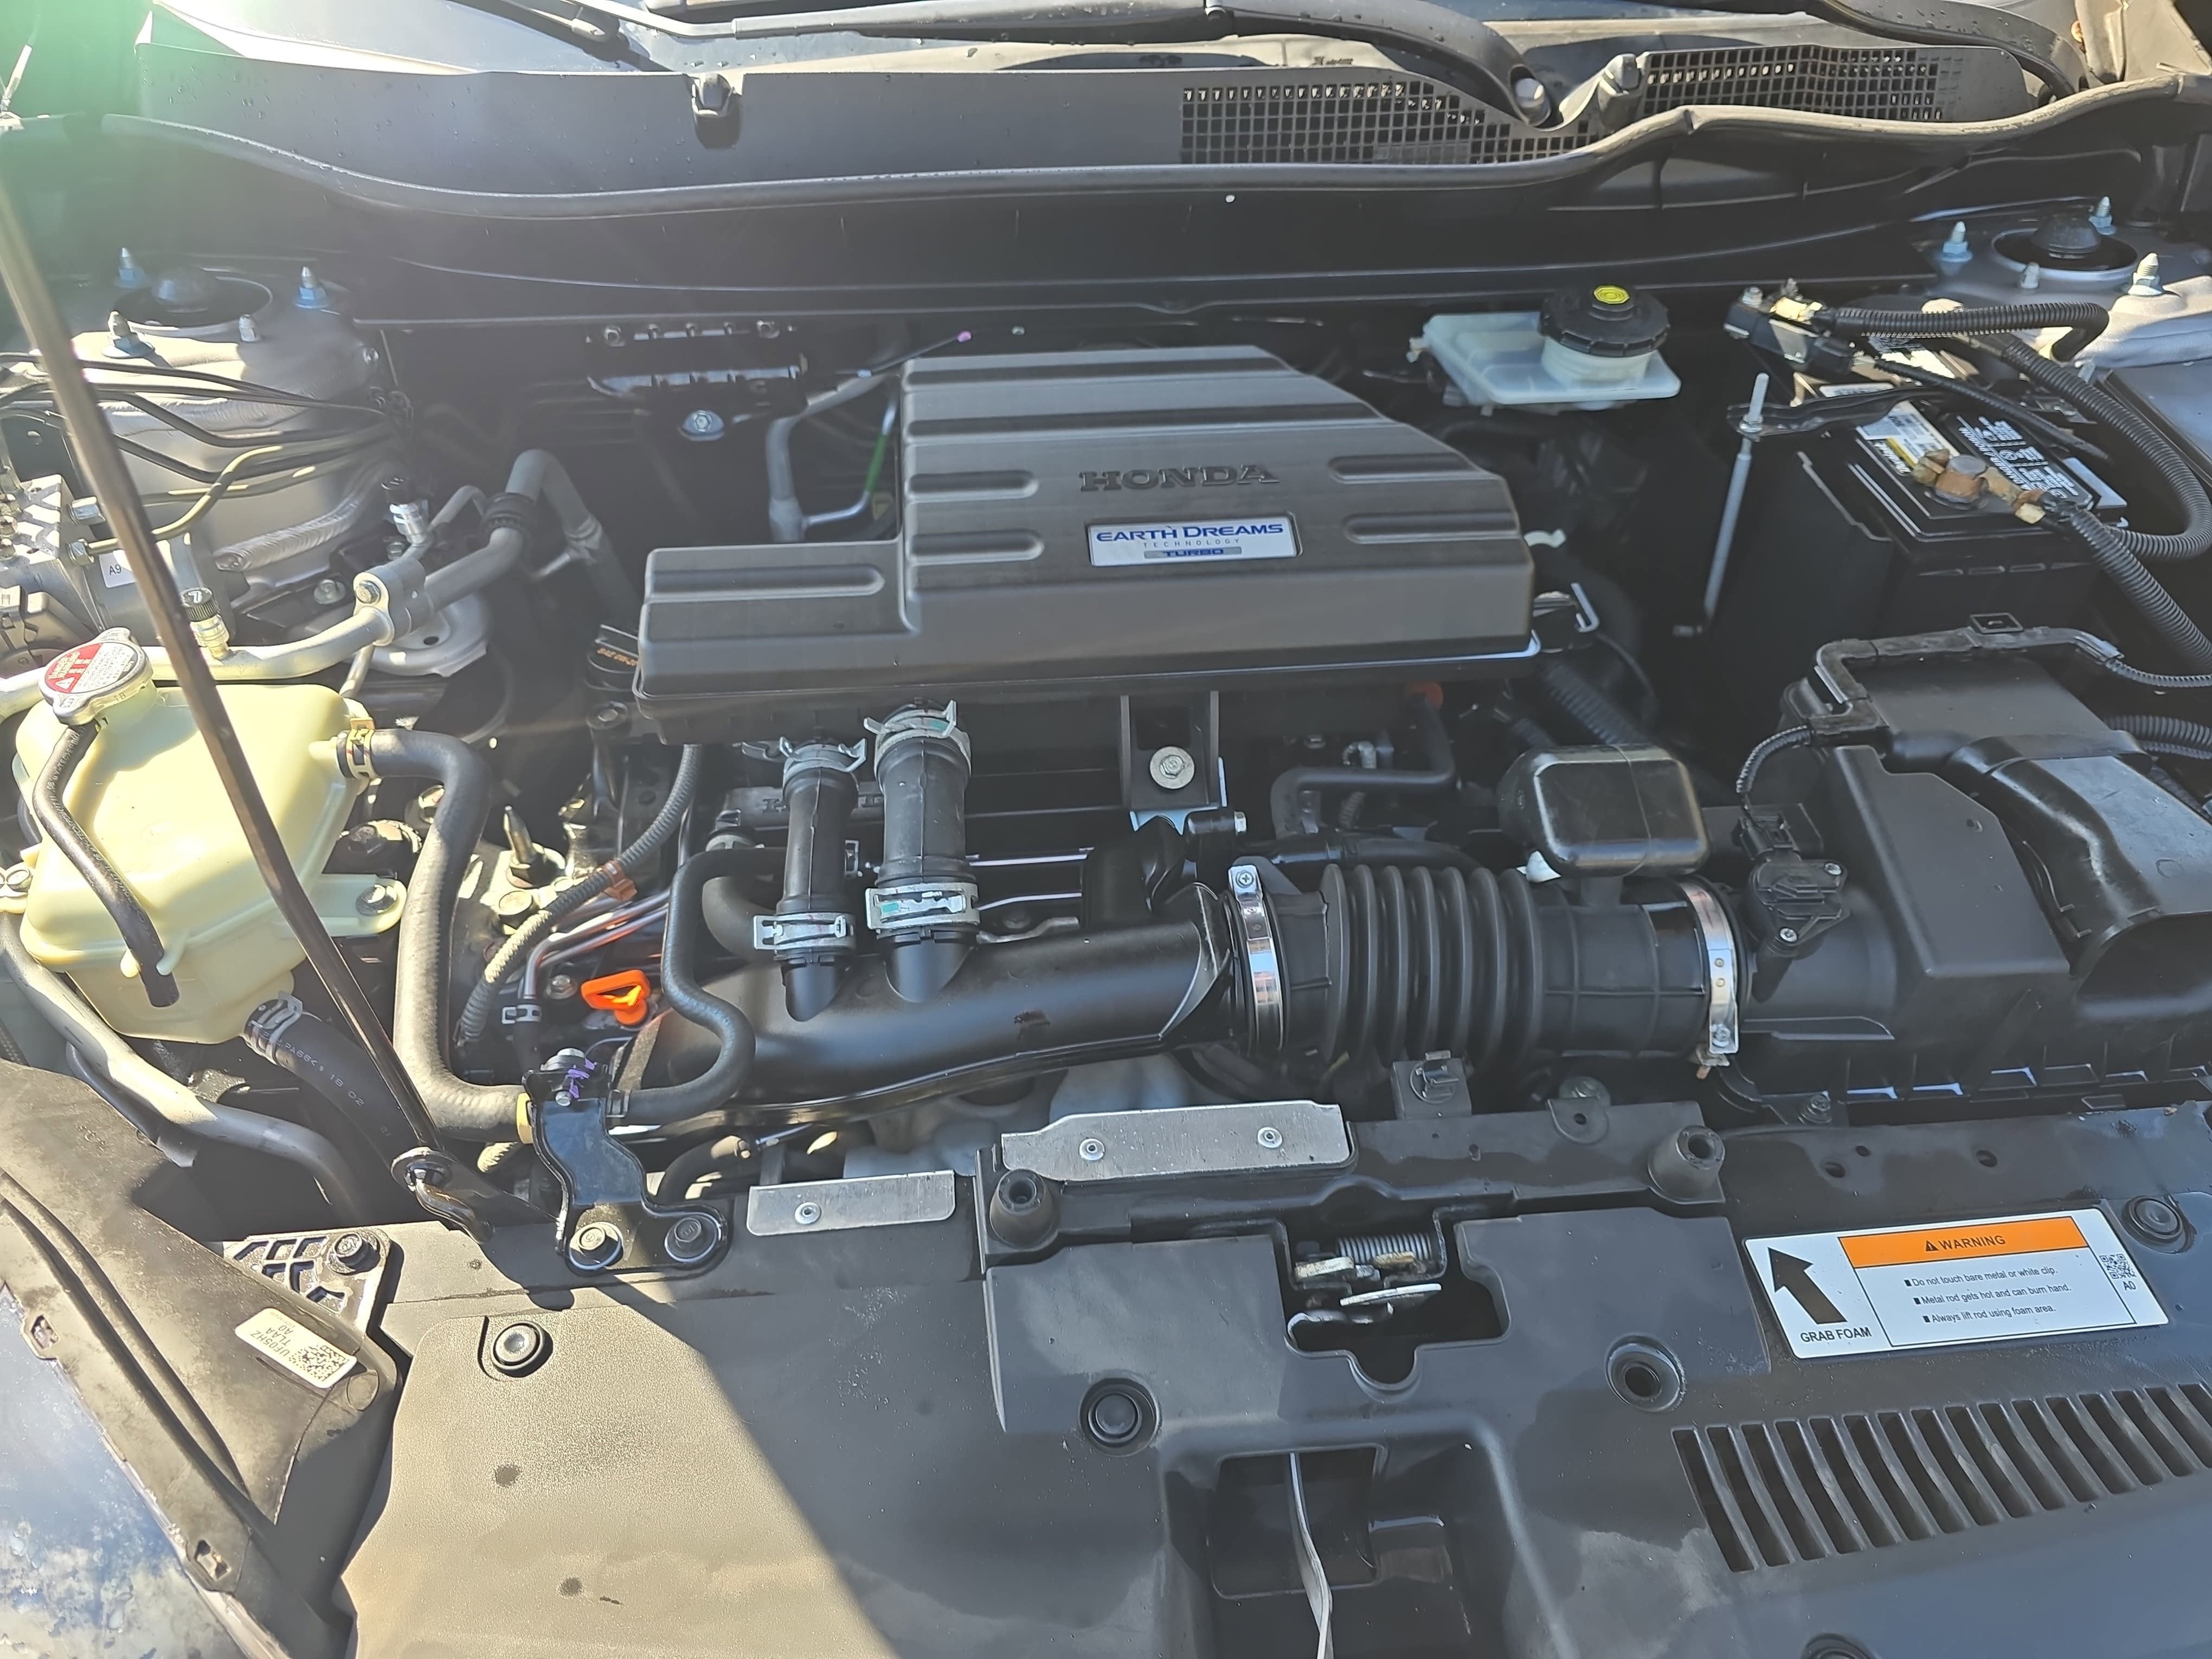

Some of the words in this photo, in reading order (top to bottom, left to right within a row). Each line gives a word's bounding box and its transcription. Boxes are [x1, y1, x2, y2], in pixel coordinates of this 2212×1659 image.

[1079, 464, 1279, 491] HONDA
[1097, 528, 1177, 542] EARTH
[1184, 524, 1283, 538] DREAMS
[1144, 539, 1240, 548] TECHNOLOGY
[1163, 548, 1224, 557] TURBO
[110, 564, 121, 575] A9
[348, 1091, 364, 1106] 02
[1939, 1235, 2006, 1251] WARNING
[1912, 1277, 1925, 1287] Do
[1927, 1276, 1939, 1285] not
[1940, 1274, 1962, 1284] touch
[1964, 1271, 1983, 1282] bare
[1985, 1270, 2007, 1280] metal
[2018, 1267, 2039, 1278] white
[2041, 1266, 2058, 1278] clip.
[1922, 1294, 1944, 1304] Metal
[1947, 1293, 1959, 1302] rod
[1962, 1291, 1978, 1302] gets
[1980, 1290, 1994, 1300] hot
[1996, 1289, 2010, 1298] and
[2012, 1288, 2025, 1297] can
[2047, 1283, 2071, 1294] hand.
[1932, 1312, 1959, 1323] Always
[1962, 1311, 1971, 1321] lift
[1973, 1310, 1986, 1319] rod
[1989, 1308, 2010, 1320] using
[2012, 1306, 2032, 1316] foam
[2034, 1306, 2055, 1314] area.
[250, 1330, 290, 1356] UF05HZ
[266, 1327, 291, 1346] TLAA
[1801, 1330, 1834, 1343] GRAB
[1836, 1327, 1872, 1340] FOAM
